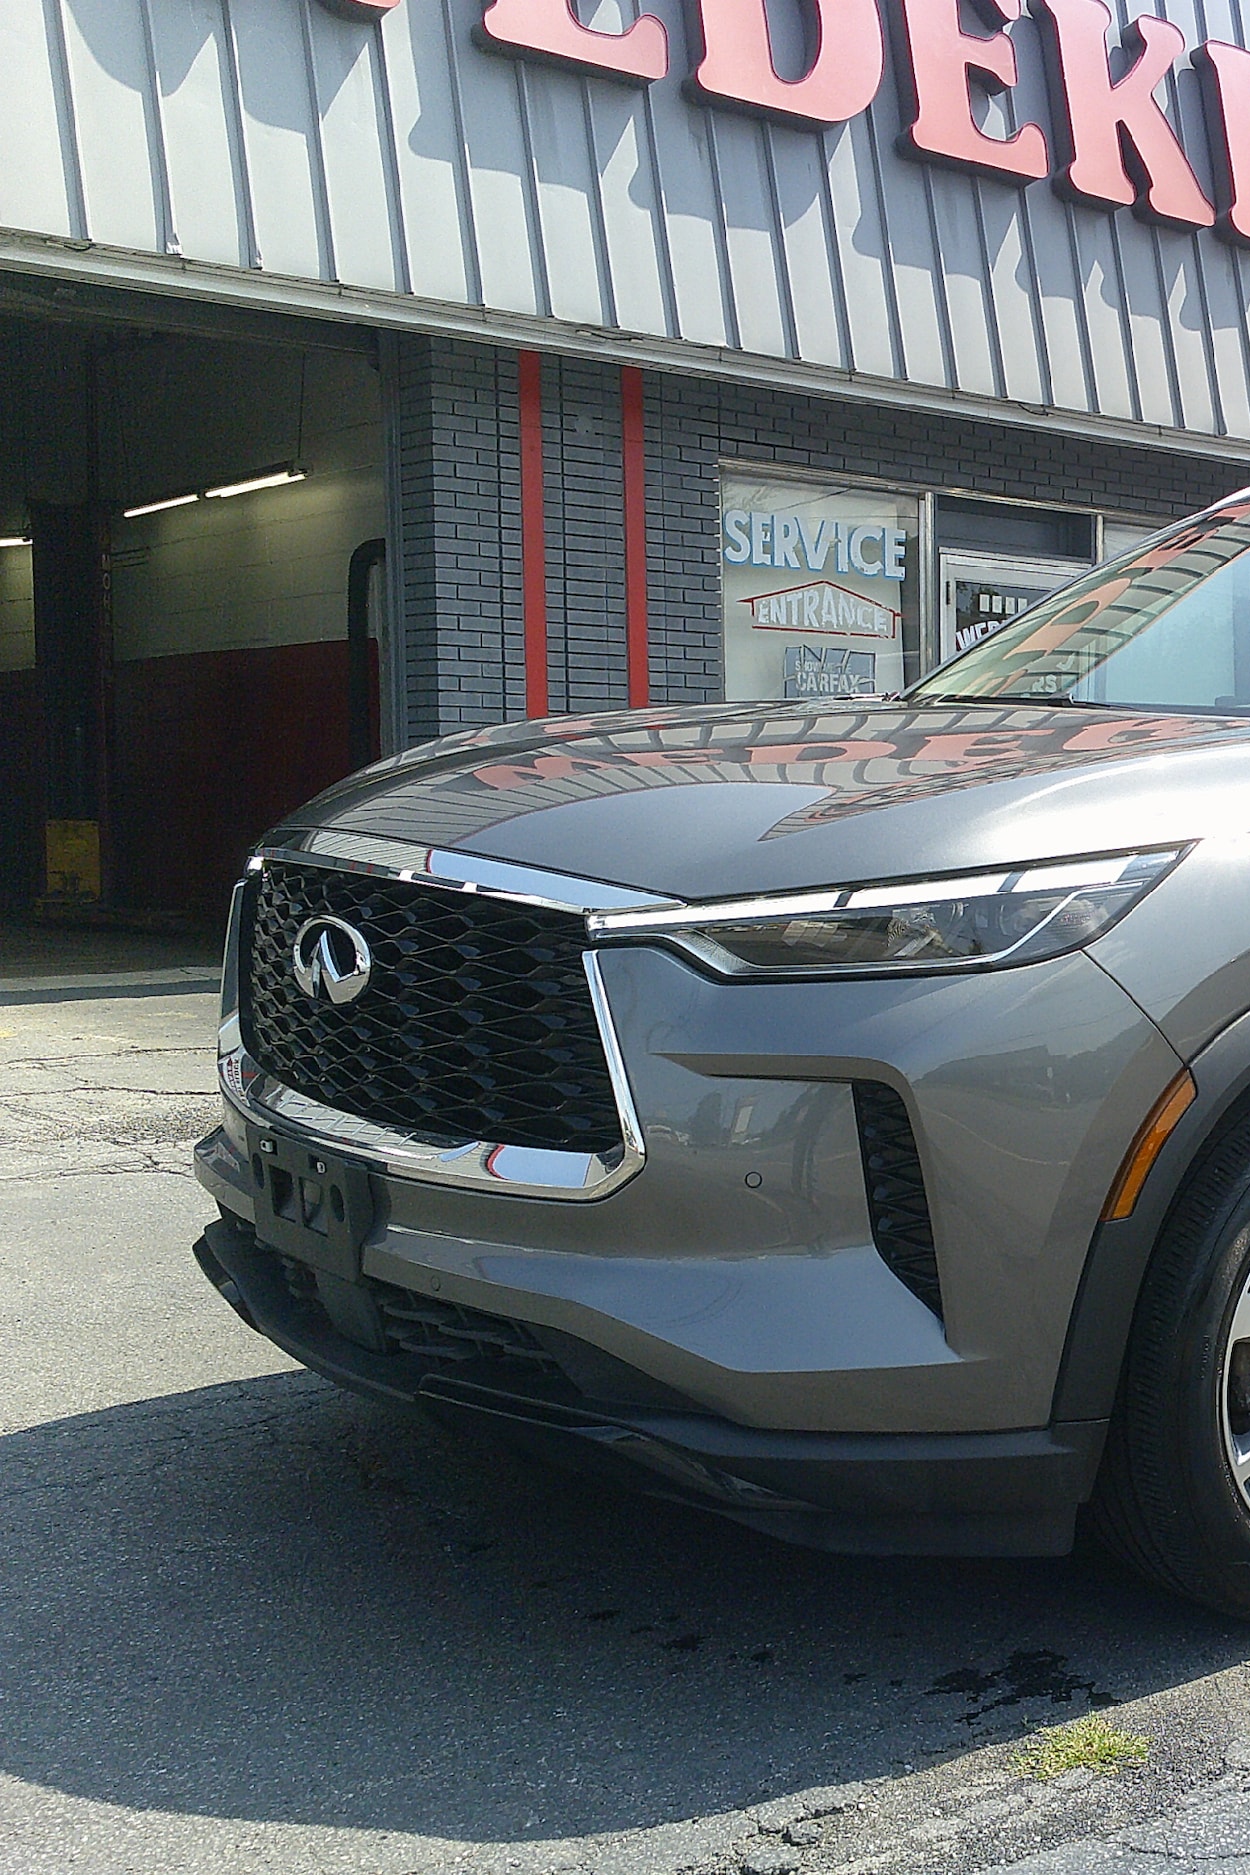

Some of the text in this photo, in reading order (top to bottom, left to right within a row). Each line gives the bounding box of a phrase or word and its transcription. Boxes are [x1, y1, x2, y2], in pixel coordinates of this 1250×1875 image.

[724, 509, 907, 581] SERVICE
[758, 586, 888, 632] ENTRANCE
[796, 673, 860, 693] CARFAX
[836, 663, 852, 675] TE
